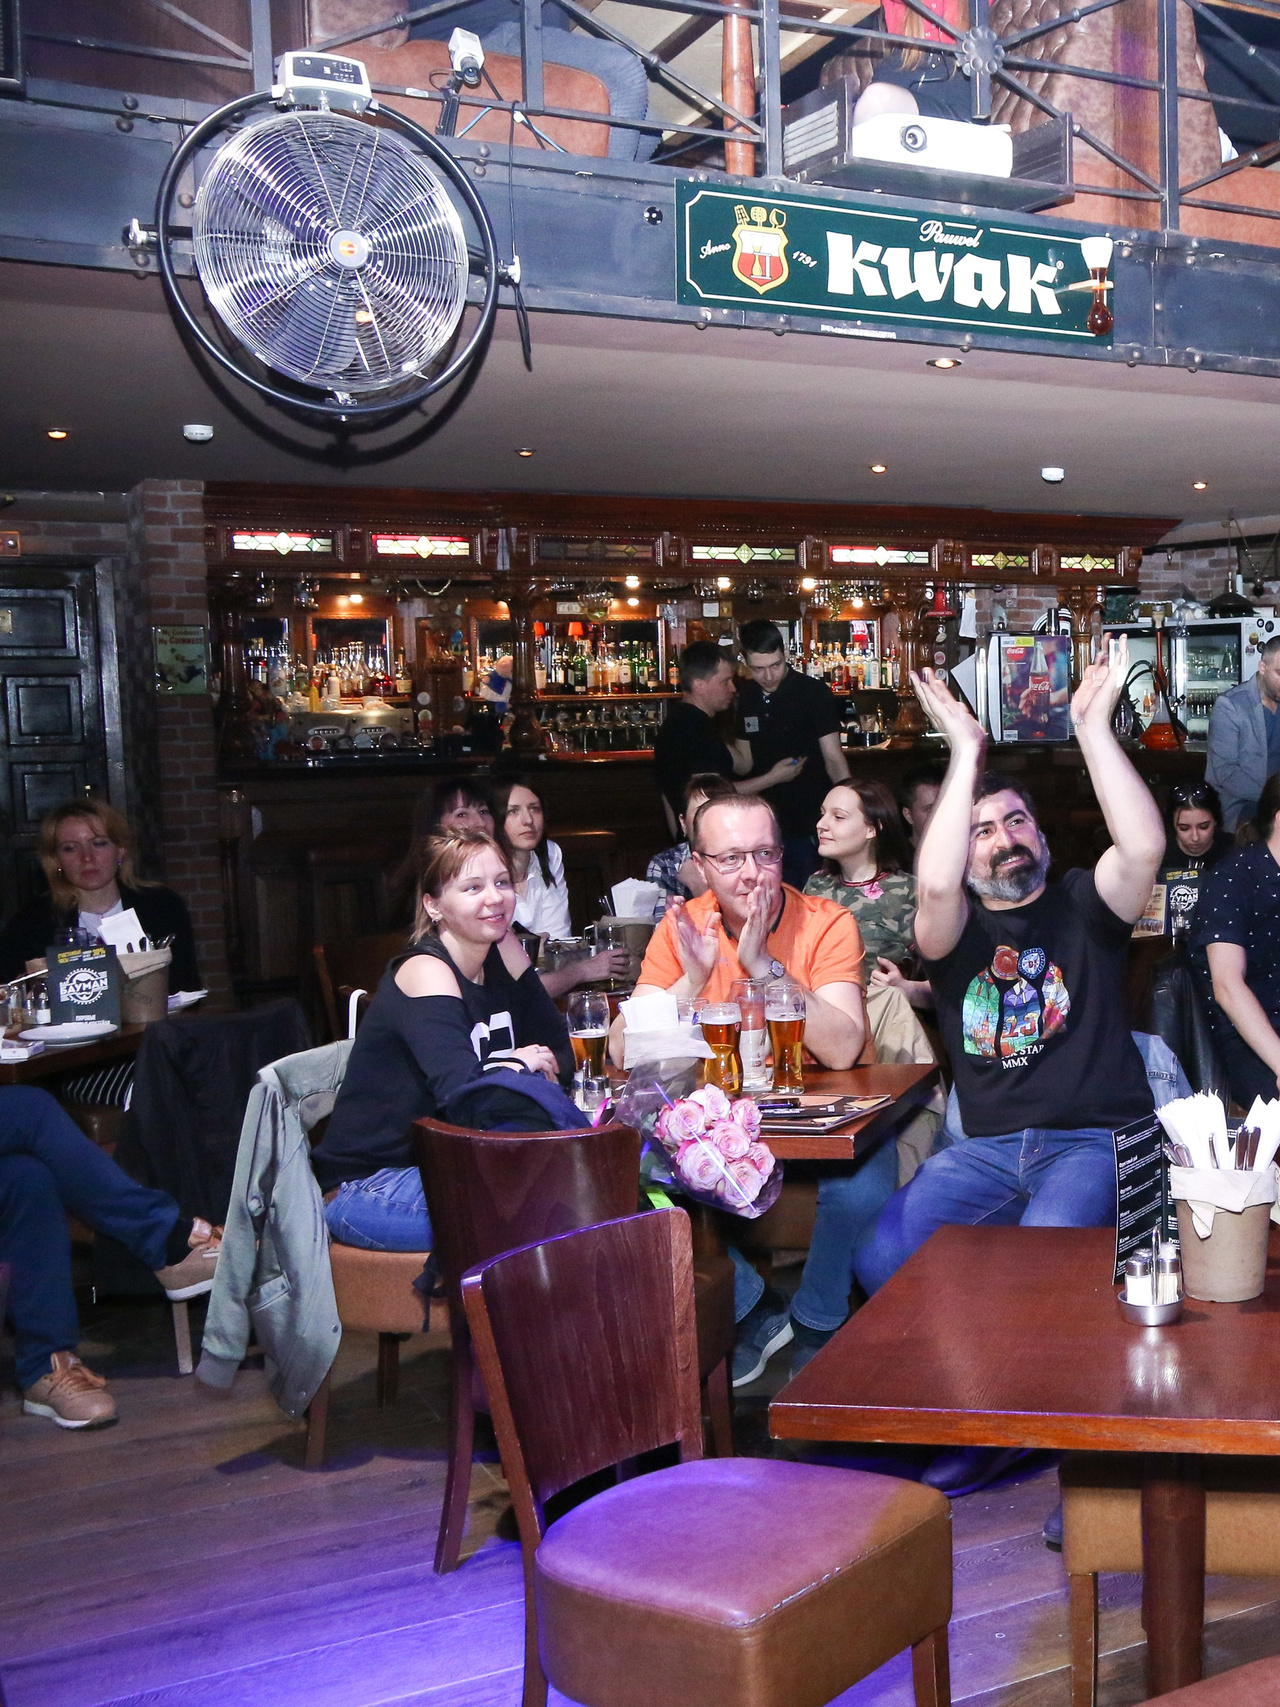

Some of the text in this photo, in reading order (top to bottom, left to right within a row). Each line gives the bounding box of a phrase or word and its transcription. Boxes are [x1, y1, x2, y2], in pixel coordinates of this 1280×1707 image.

[919, 219, 984, 248] Pauwel
[699, 239, 732, 259] Anno
[792, 250, 818, 268] 1791
[60, 977, 108, 995] БАУМАН
[1001, 1056, 1029, 1070] MMX
